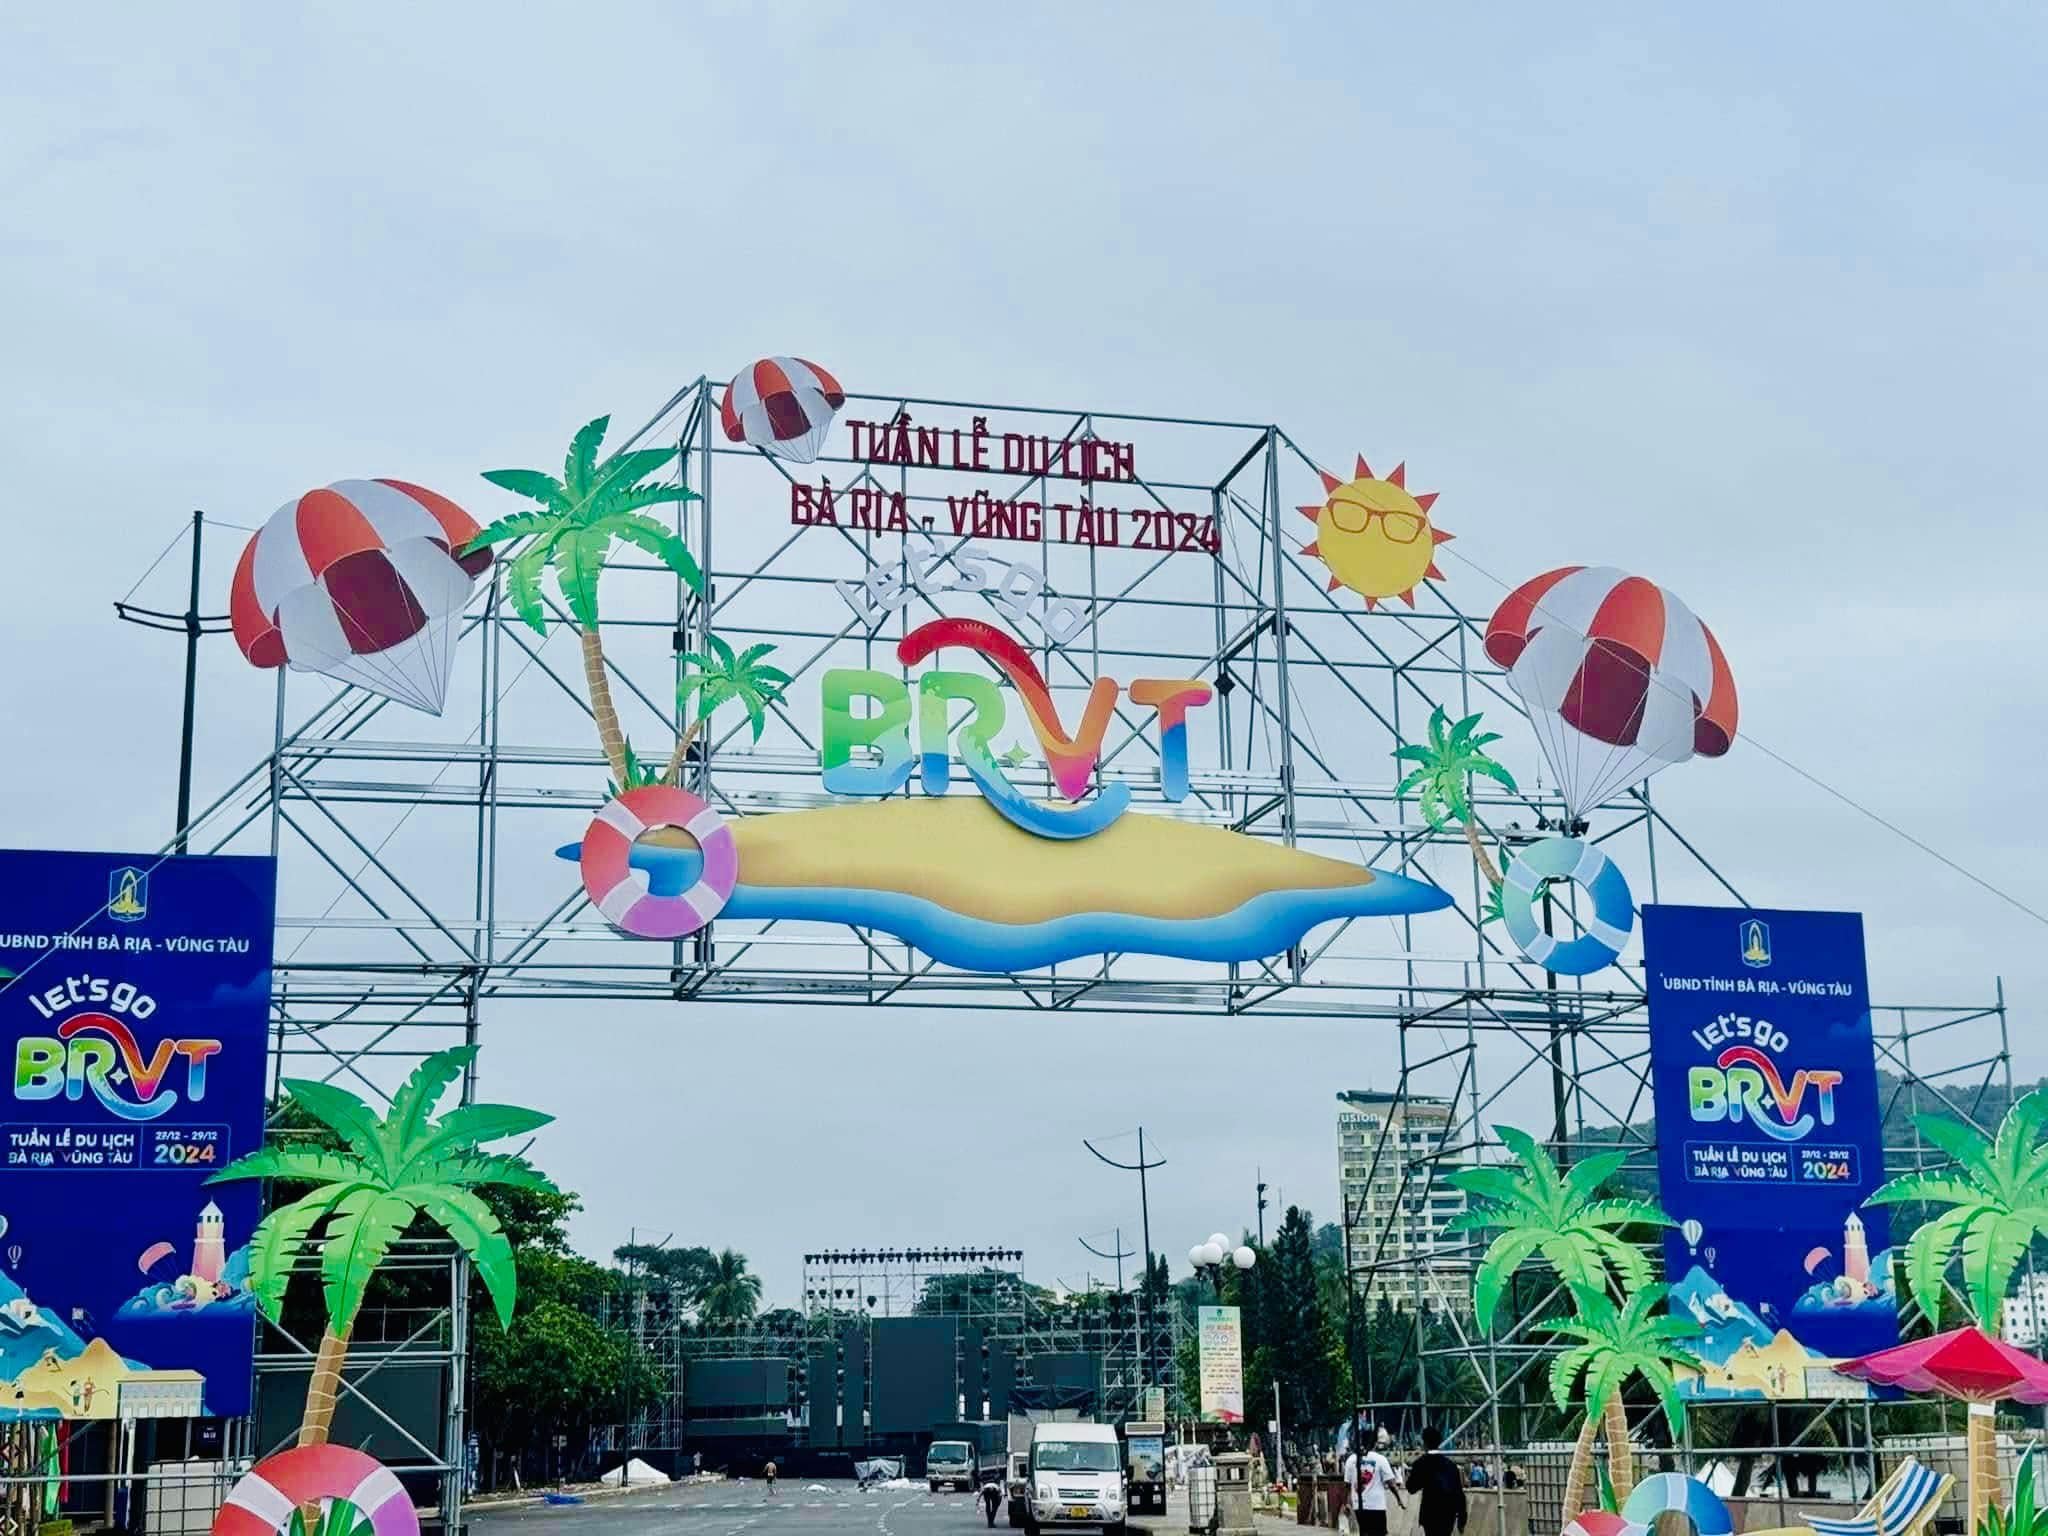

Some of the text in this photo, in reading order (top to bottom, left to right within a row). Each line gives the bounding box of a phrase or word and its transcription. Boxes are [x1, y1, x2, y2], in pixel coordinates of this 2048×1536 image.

[845, 413, 1134, 486] TUẦN LỄ DU LỊCH
[791, 474, 837, 527] BÀ
[851, 489, 908, 537] RỊA
[947, 490, 1041, 542] VŨNG
[1054, 494, 1118, 547] TÀU
[1131, 509, 1222, 553] 2024
[821, 617, 1213, 840] BRVT
[0, 934, 49, 950] UBND
[52, 931, 93, 950] TỈNH
[97, 934, 122, 950] BÀ
[124, 937, 152, 954] RỊA
[165, 937, 214, 952] VŨNG
[217, 937, 250, 953] TÀU
[1663, 976, 1701, 990] UBND
[1703, 975, 1735, 992] TỈNH
[1737, 976, 1755, 992] BÀ
[1758, 980, 1779, 996] RỊA
[1788, 979, 1826, 995] VŨNG
[1827, 981, 1852, 996] TÀU
[14, 1012, 222, 1121] BRVT
[1688, 1046, 1843, 1141] BRVT
[10, 1128, 51, 1147] TUẦN
[75, 1133, 97, 1147] DU
[102, 1133, 134, 1150] LỊCH
[8, 1149, 28, 1163] BÀ
[63, 1150, 104, 1164] VŨNG
[107, 1150, 133, 1164] TÀU
[153, 1143, 217, 1164] 2024
[1742, 1151, 1759, 1163] DU
[1803, 1161, 1851, 1180] 2024
